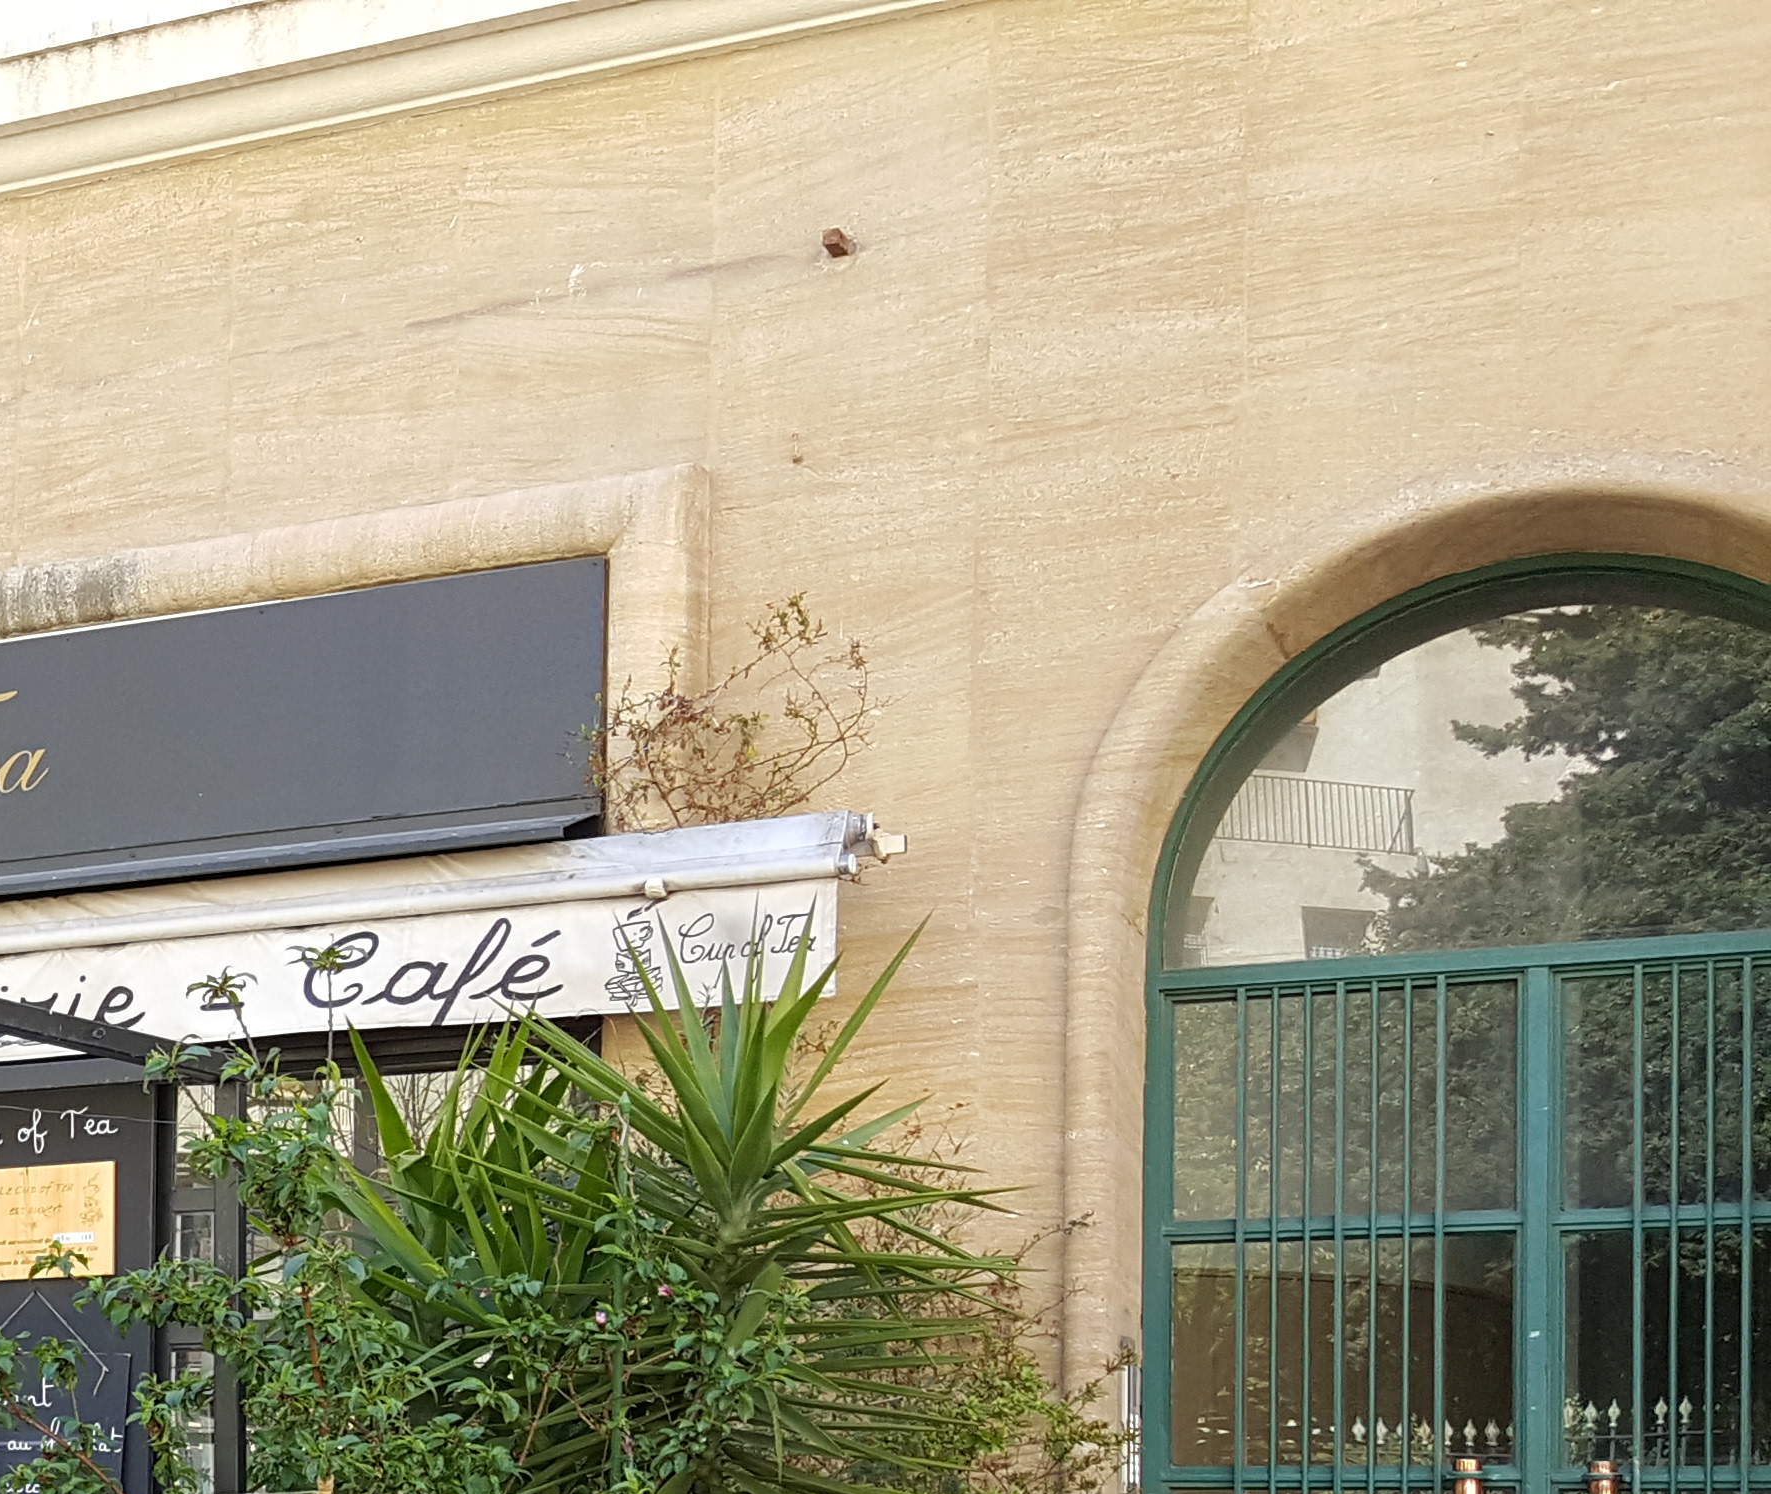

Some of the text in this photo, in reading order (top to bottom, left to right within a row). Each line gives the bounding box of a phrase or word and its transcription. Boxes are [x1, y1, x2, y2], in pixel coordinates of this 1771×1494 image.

[303, 916, 565, 1026] Café
[678, 912, 736, 989] Cup
[17, 1108, 48, 1155] of
[60, 1106, 119, 1140] Tea
[7, 1439, 33, 1451] au
